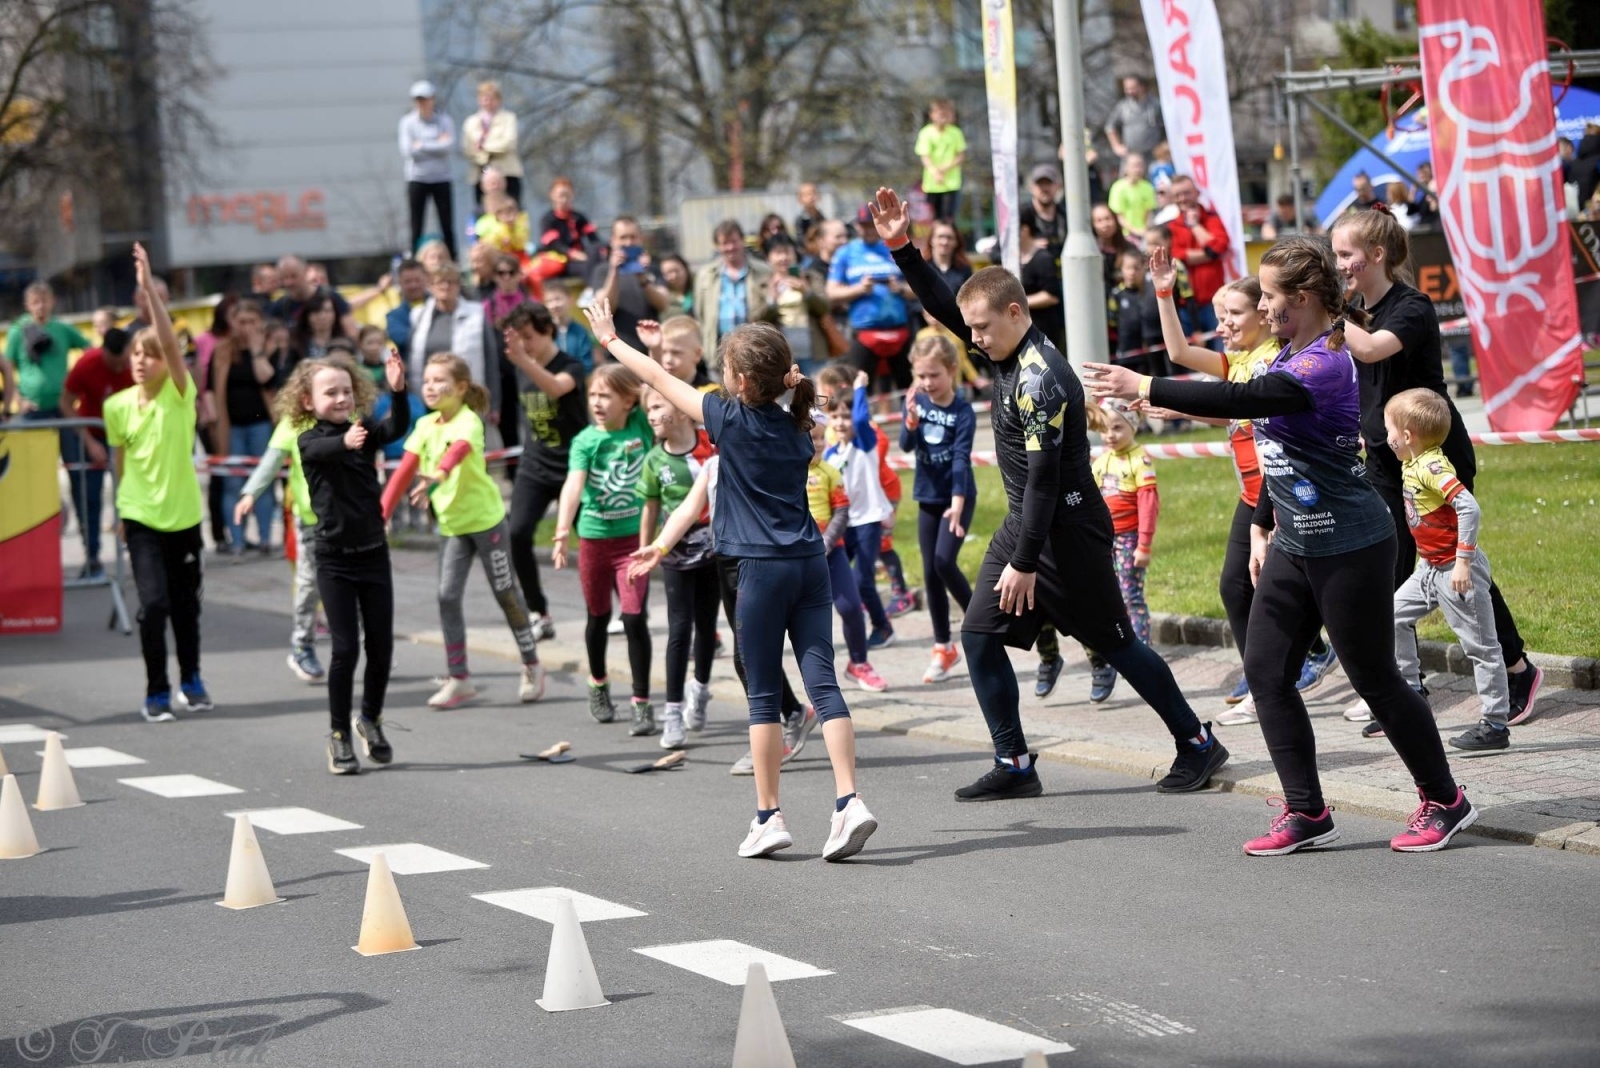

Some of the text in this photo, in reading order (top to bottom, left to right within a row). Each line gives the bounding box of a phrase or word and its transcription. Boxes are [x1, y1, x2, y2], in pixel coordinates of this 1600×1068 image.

[1272, 308, 1289, 324] 46
[1293, 511, 1333, 521] MECHANIKA
[1293, 518, 1336, 529] POJAZDOWA
[1315, 527, 1334, 535] Pyszny
[490, 548, 512, 592] SLEEP
